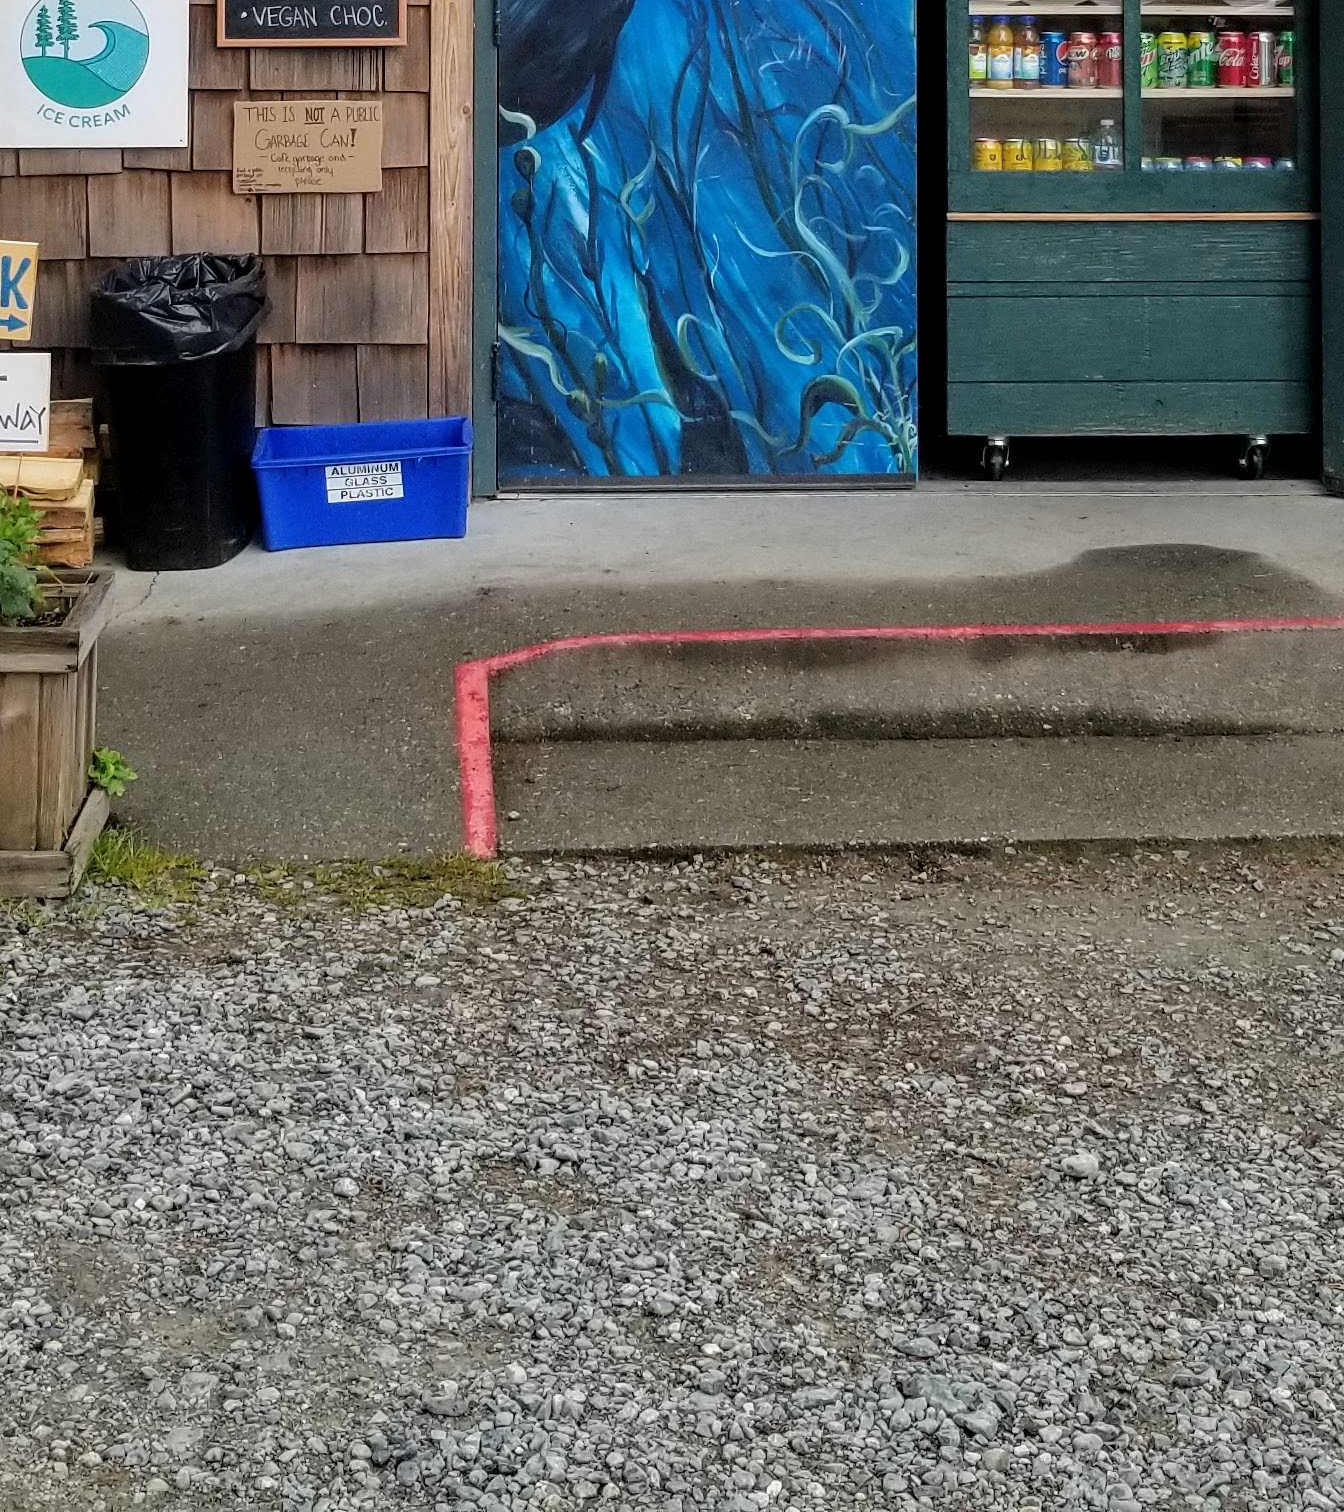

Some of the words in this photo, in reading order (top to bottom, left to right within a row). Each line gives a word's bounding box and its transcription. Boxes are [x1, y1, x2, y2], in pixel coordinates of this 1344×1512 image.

[252, 5, 317, 28] VEGAN
[330, 5, 387, 28] CHOC.
[37, 104, 63, 125] ICE
[69, 104, 131, 128] CREAM
[243, 107, 276, 123] THIS
[283, 107, 295, 123] IS
[305, 107, 325, 122] NOT
[331, 108, 340, 122] A
[347, 106, 380, 122] PUBLIC
[255, 129, 309, 150] GARBAGE
[331, 463, 398, 476] ALUMINUM
[345, 476, 387, 486] GLASS
[341, 488, 394, 499] PLASTIC
